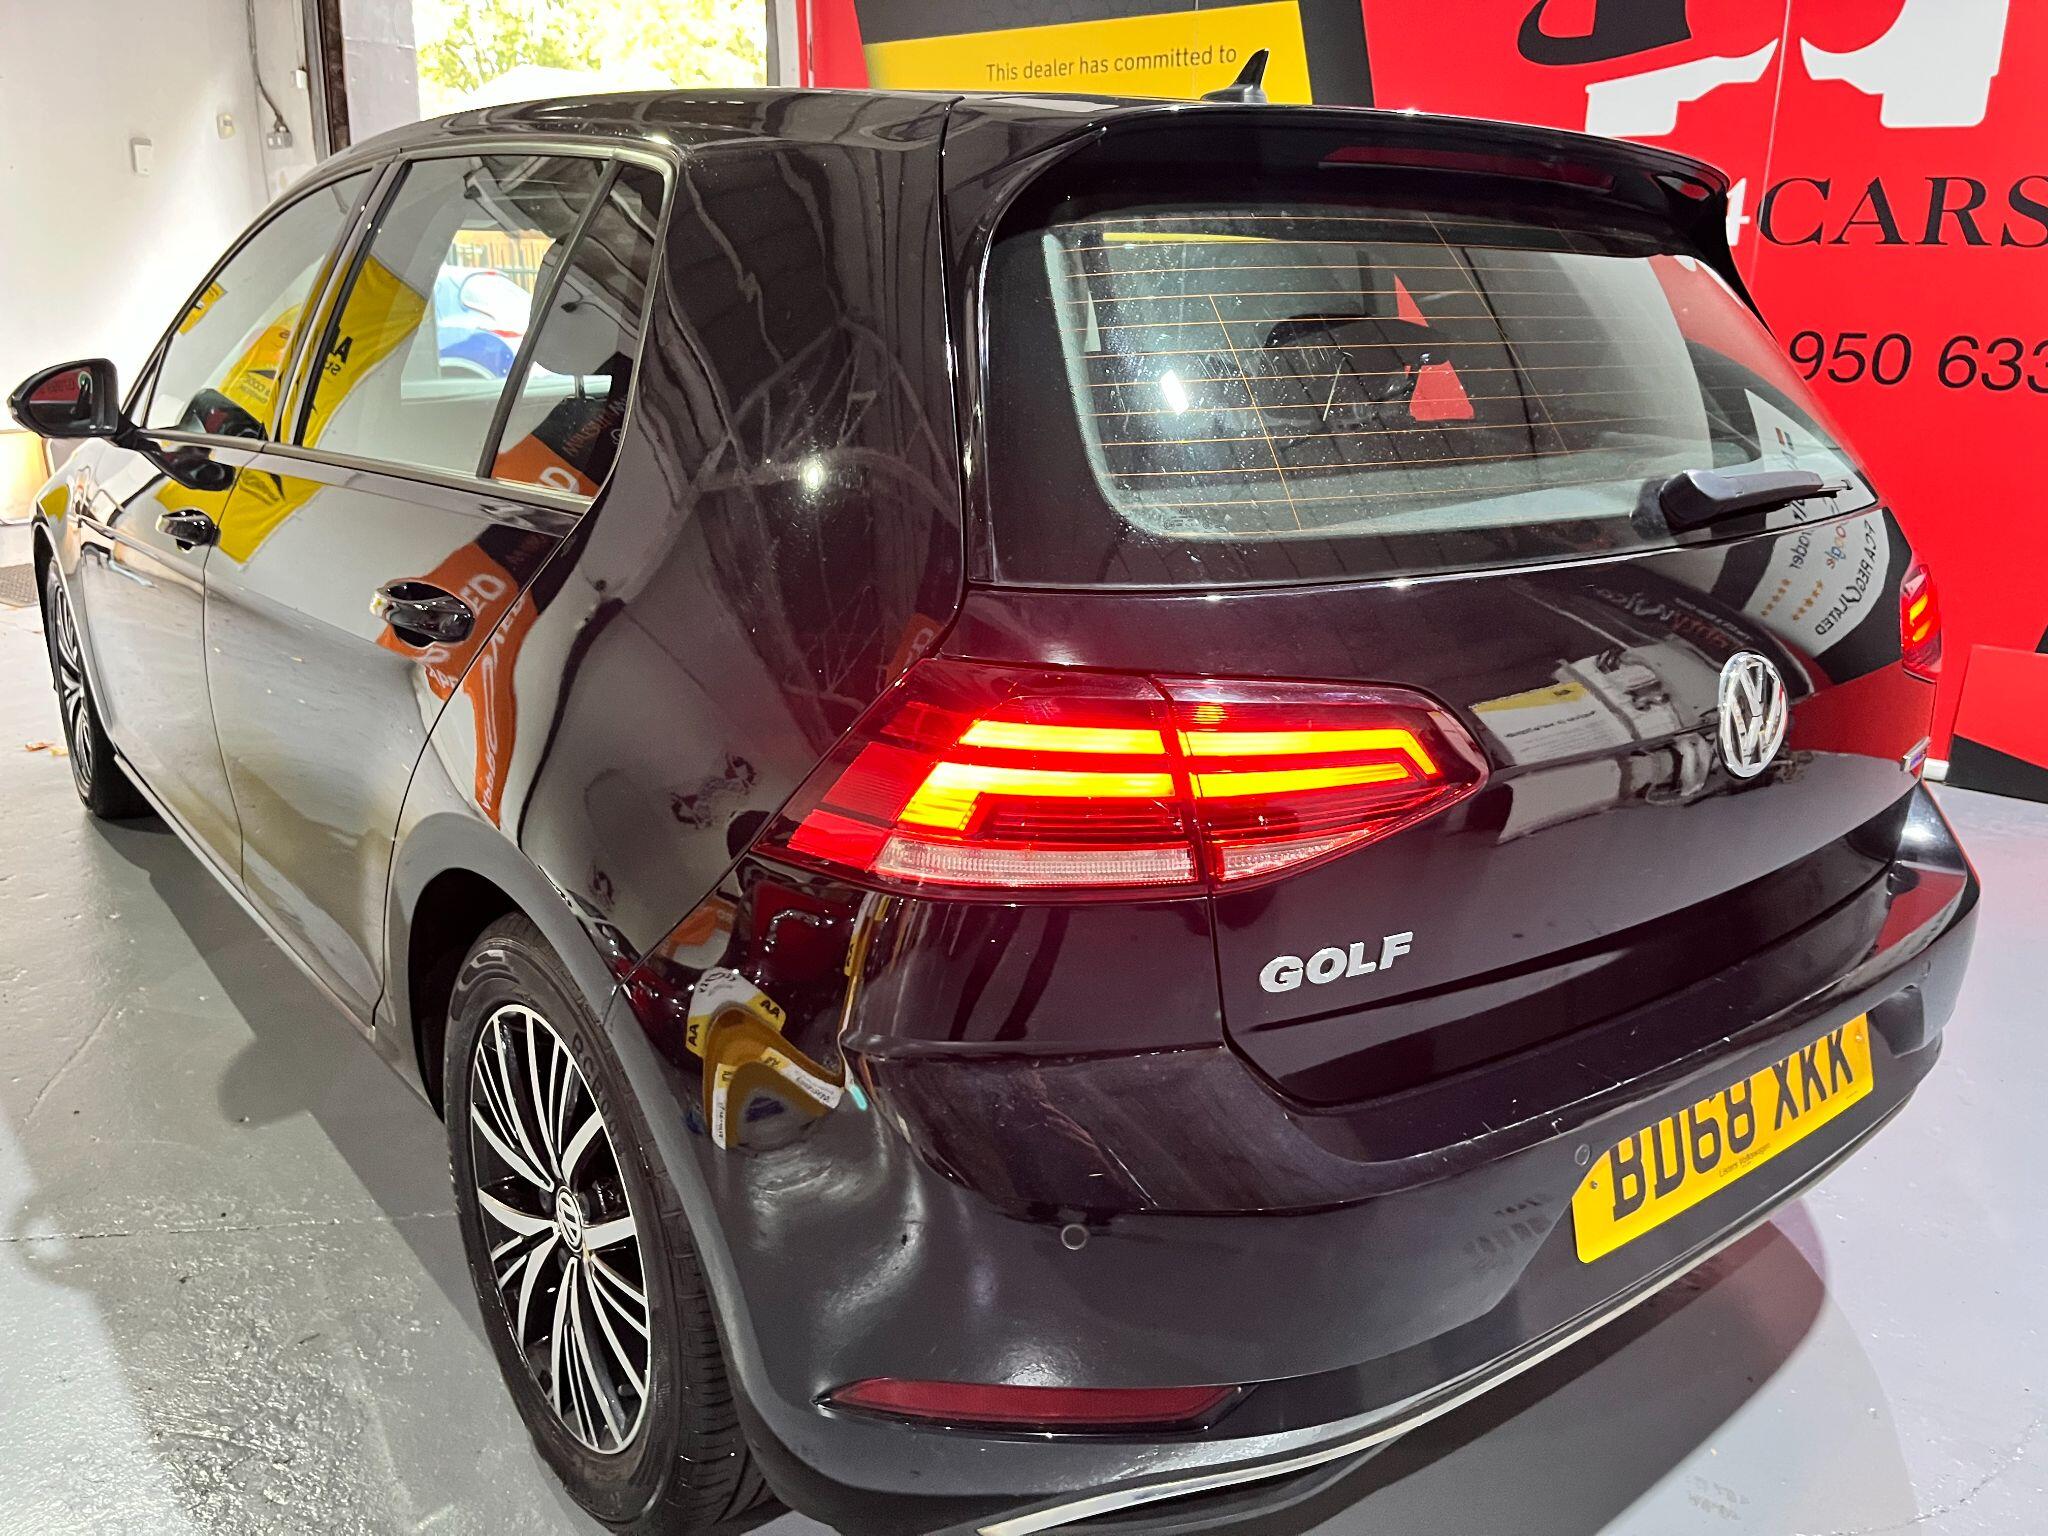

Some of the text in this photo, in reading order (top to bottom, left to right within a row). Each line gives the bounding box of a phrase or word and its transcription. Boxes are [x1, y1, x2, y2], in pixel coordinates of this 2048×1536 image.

[986, 45, 1237, 82] This dealer has committed to
[1789, 330, 1912, 386] 950
[1258, 931, 1414, 993] GOLF
[1608, 1027, 1854, 1222] BD68 XKK
